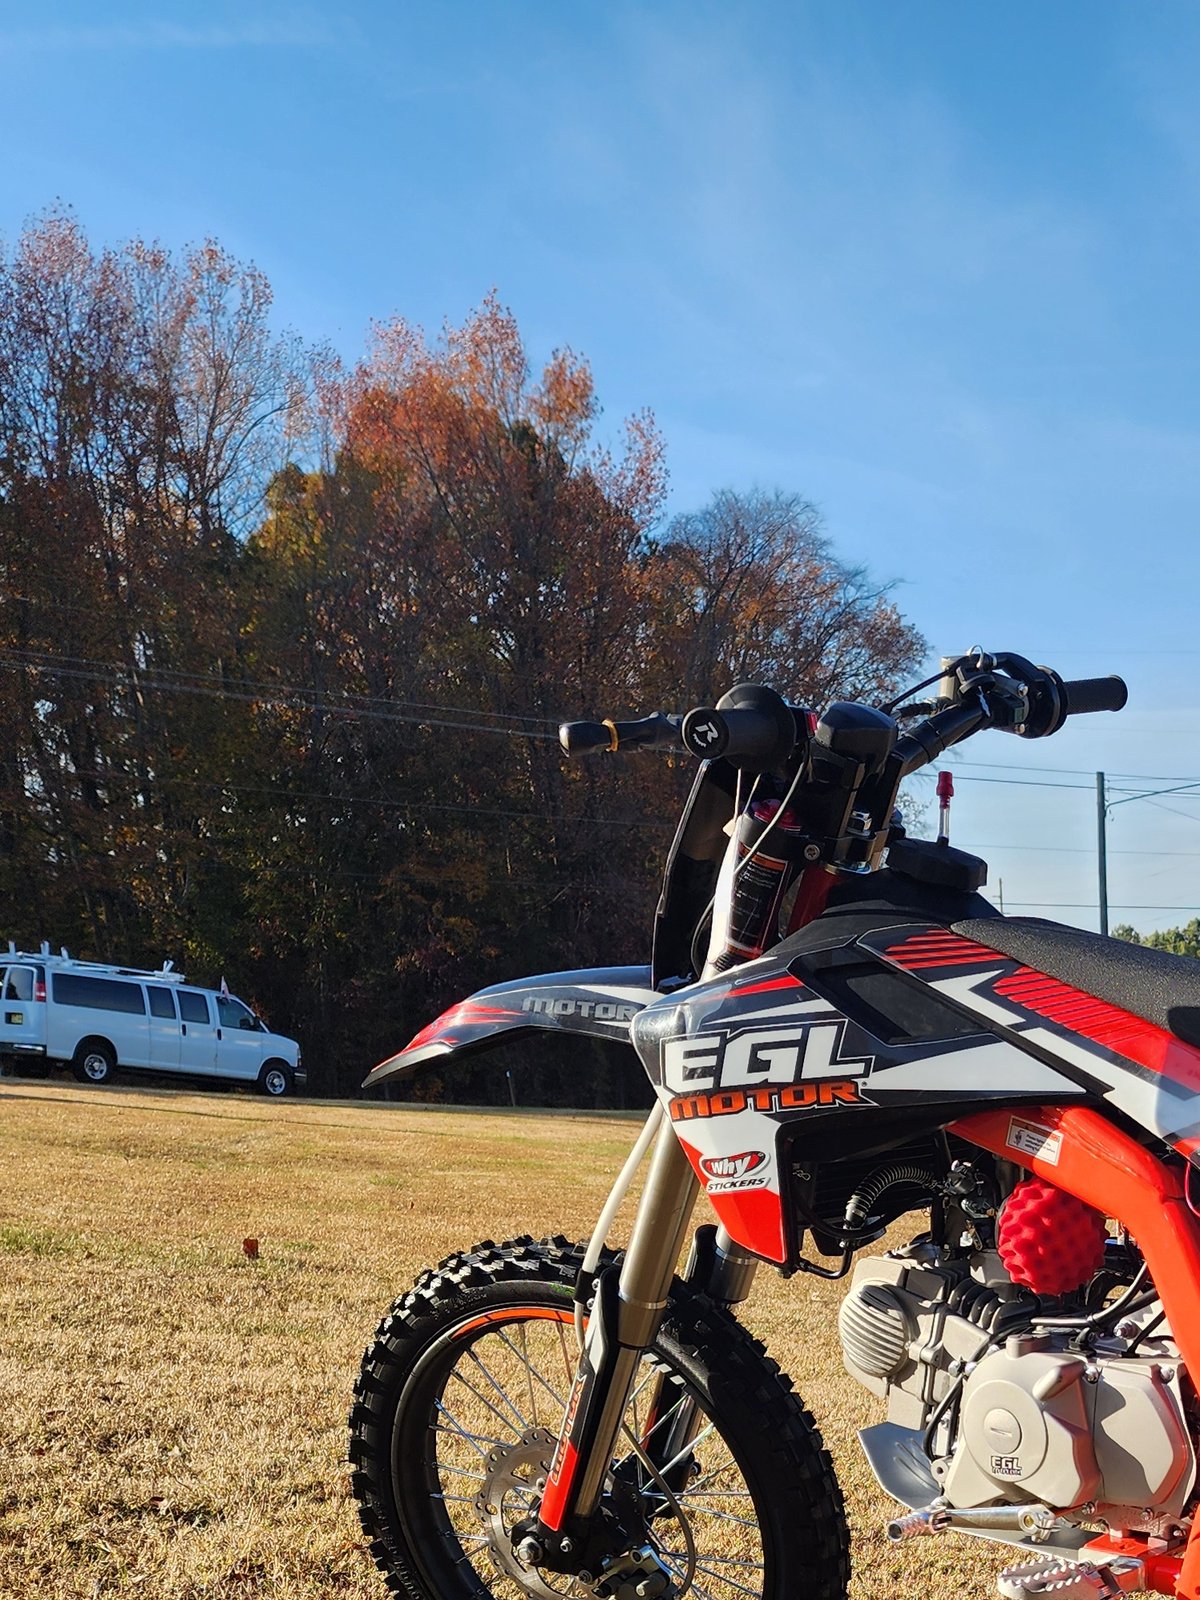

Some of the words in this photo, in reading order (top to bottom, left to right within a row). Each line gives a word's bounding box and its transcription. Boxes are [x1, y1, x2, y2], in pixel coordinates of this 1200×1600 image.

[522, 997, 638, 1020] MOTOR
[664, 1025, 866, 1094] EGL
[669, 1081, 861, 1121] MOTOR
[708, 1177, 766, 1191] STICKERS
[990, 1456, 1022, 1469] EGL
